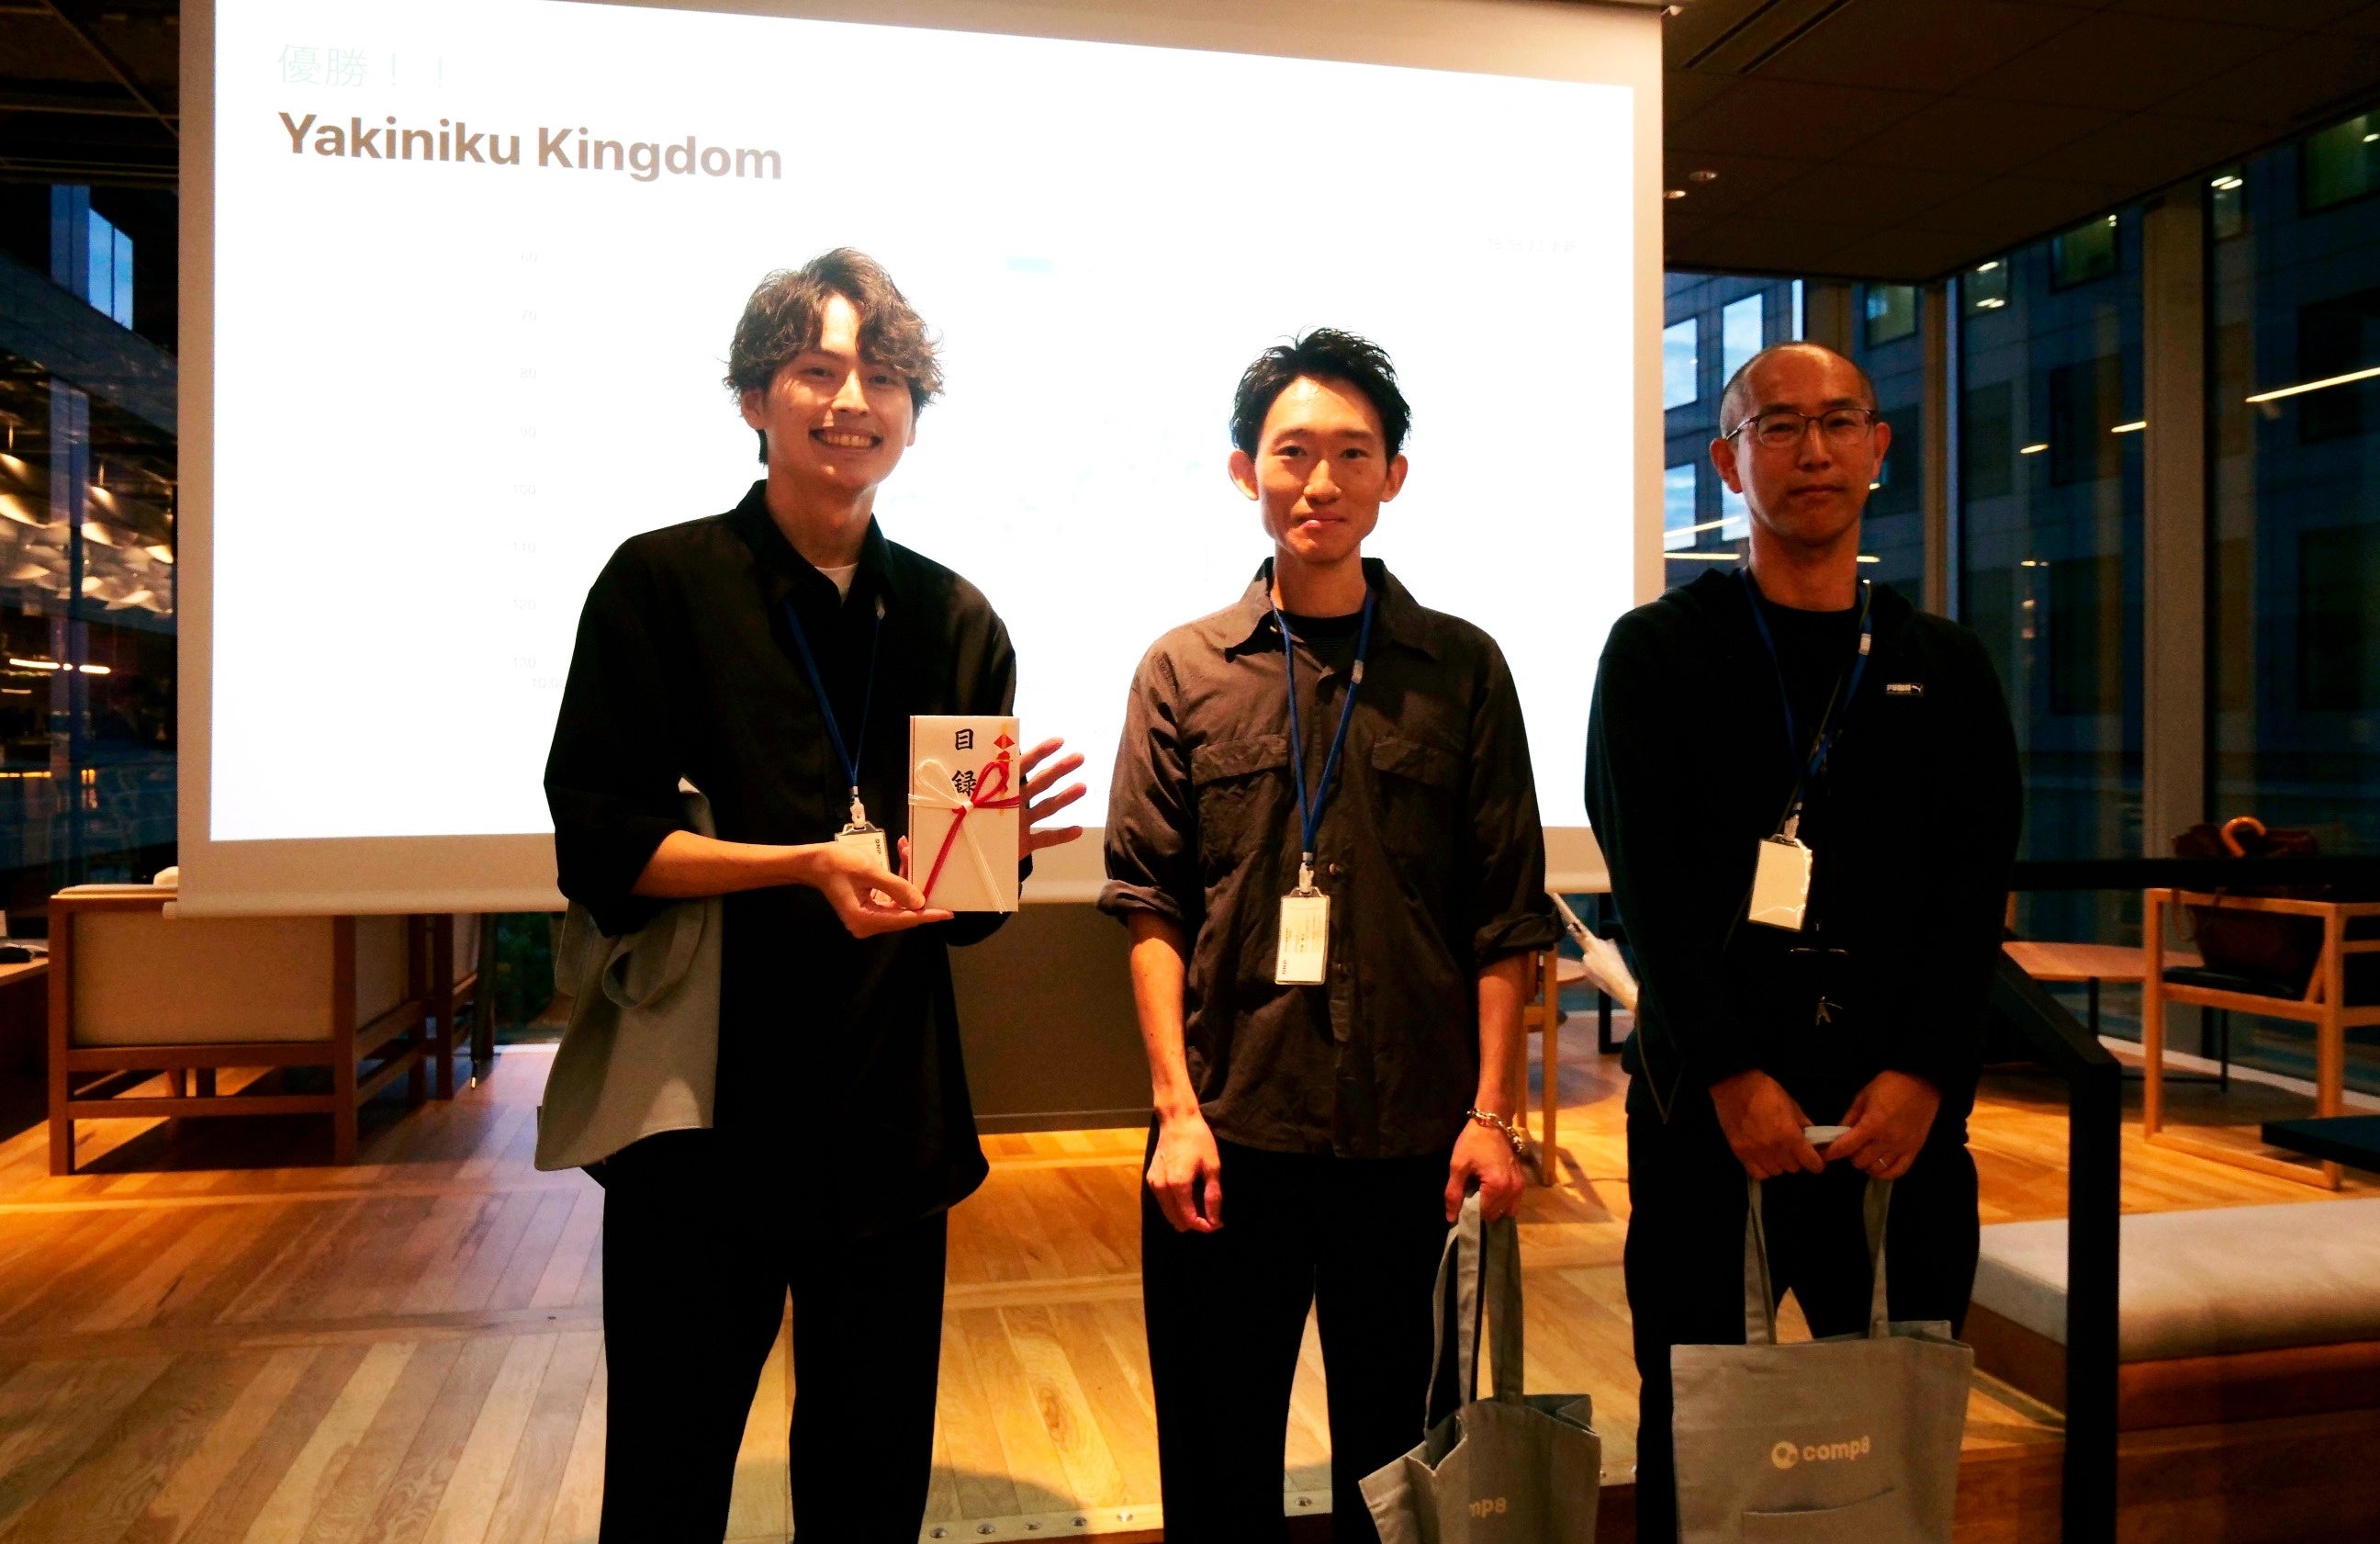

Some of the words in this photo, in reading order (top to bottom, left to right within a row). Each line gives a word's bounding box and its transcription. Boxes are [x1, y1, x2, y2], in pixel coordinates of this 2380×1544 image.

[278, 111, 520, 165] Yakiniku
[538, 127, 782, 182] Kingdom
[951, 728, 977, 796] 目録
[1469, 1497, 1507, 1517] mp8
